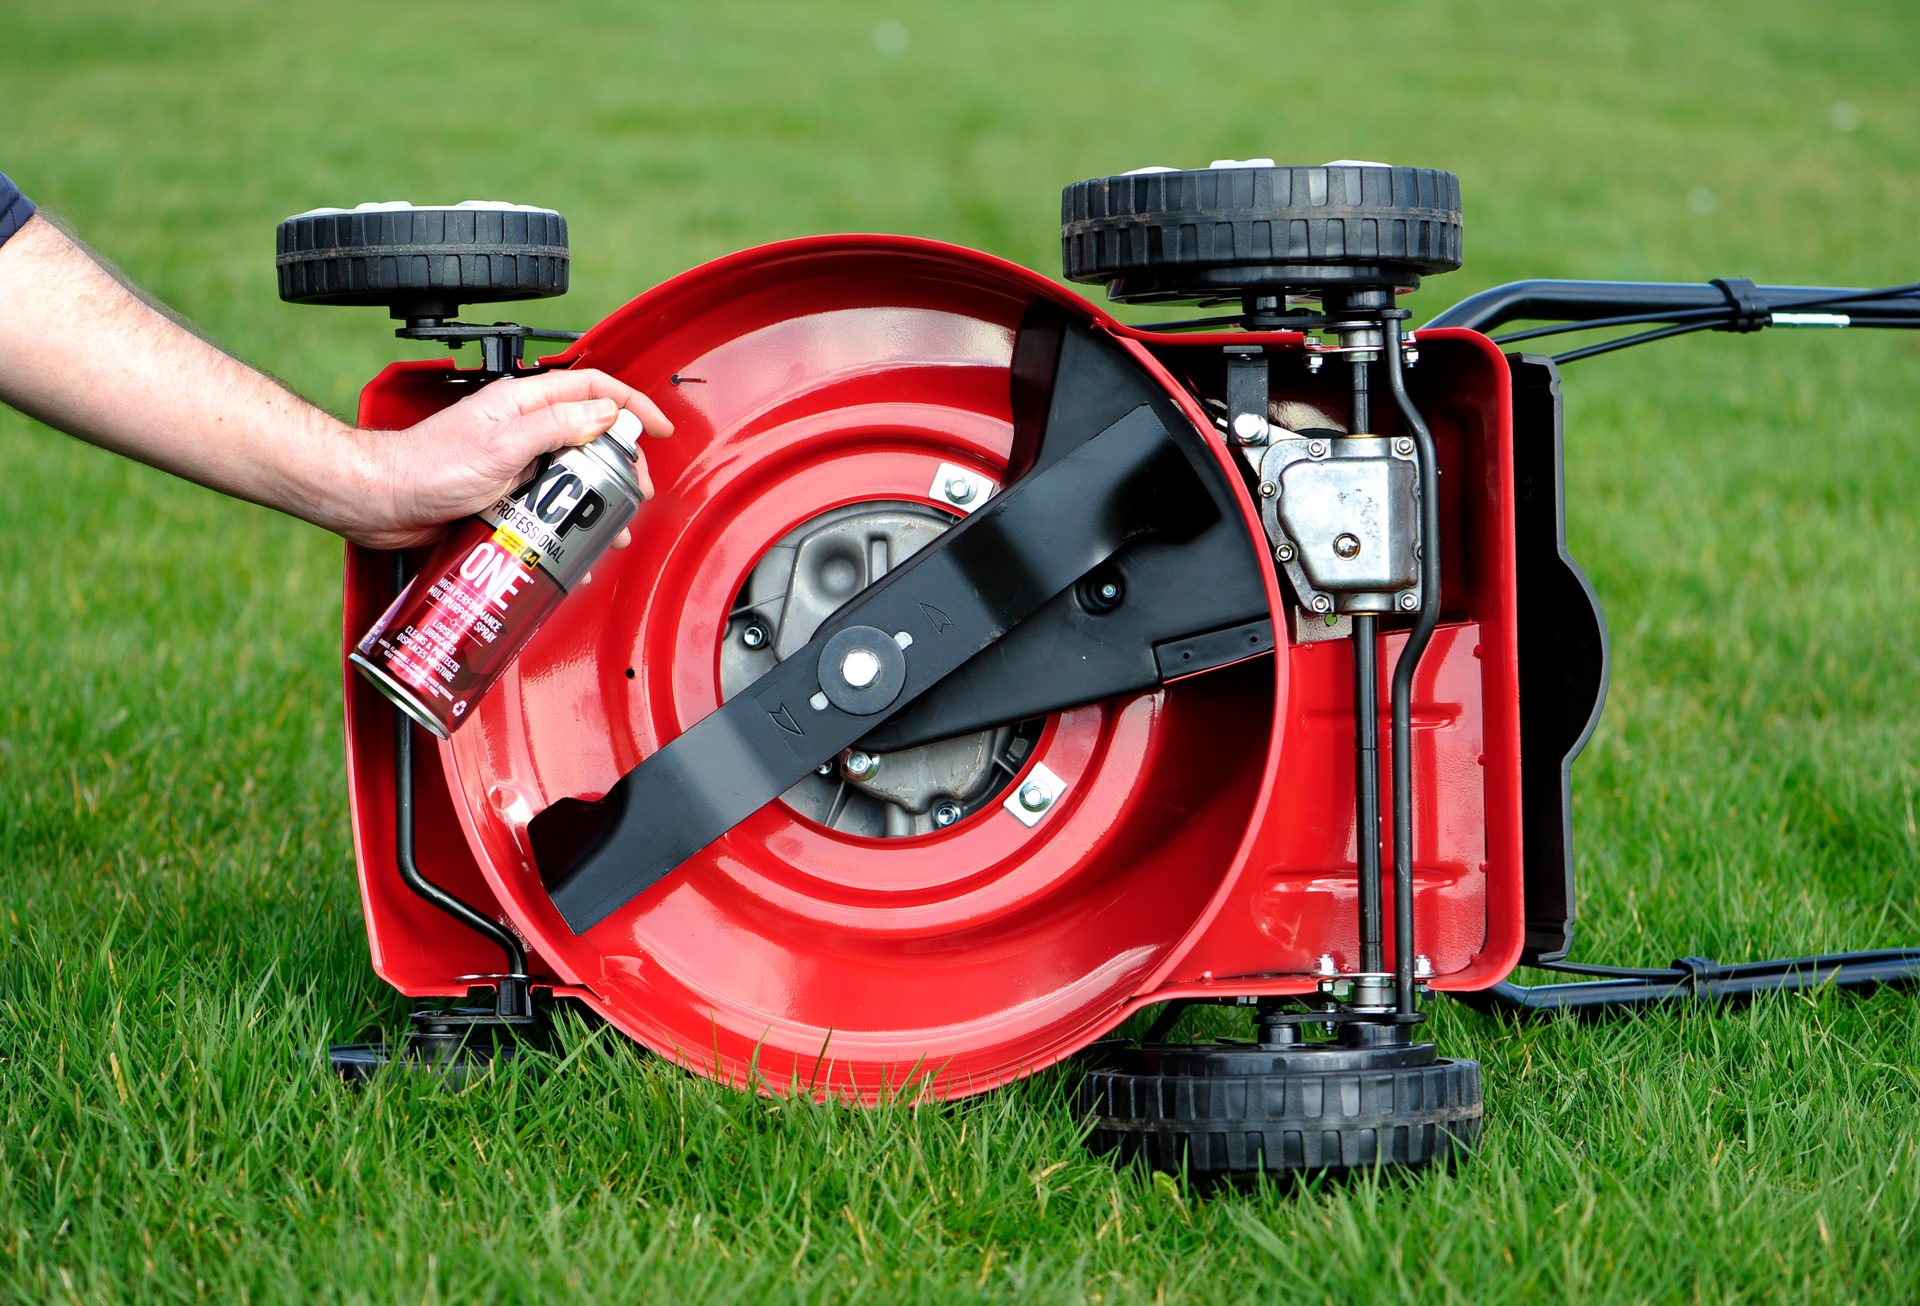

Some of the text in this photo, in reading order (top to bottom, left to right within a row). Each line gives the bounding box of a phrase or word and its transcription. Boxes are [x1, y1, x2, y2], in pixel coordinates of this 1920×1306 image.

[506, 452, 607, 541] XCP
[492, 499, 566, 564] PROFESSIONAL
[427, 585, 497, 643] MULTIPURPOSE SPRAY
[432, 619, 460, 644] LOOSENS
[437, 577, 502, 633] HIGH PERFORMANCE
[396, 632, 428, 659] DISPLACES
[424, 654, 455, 683] MOISTURE
[404, 625, 428, 645] CLEANS
[425, 642, 432, 650] &
[430, 645, 460, 673] PROTECTS
[422, 624, 457, 655] LUBRICATES
